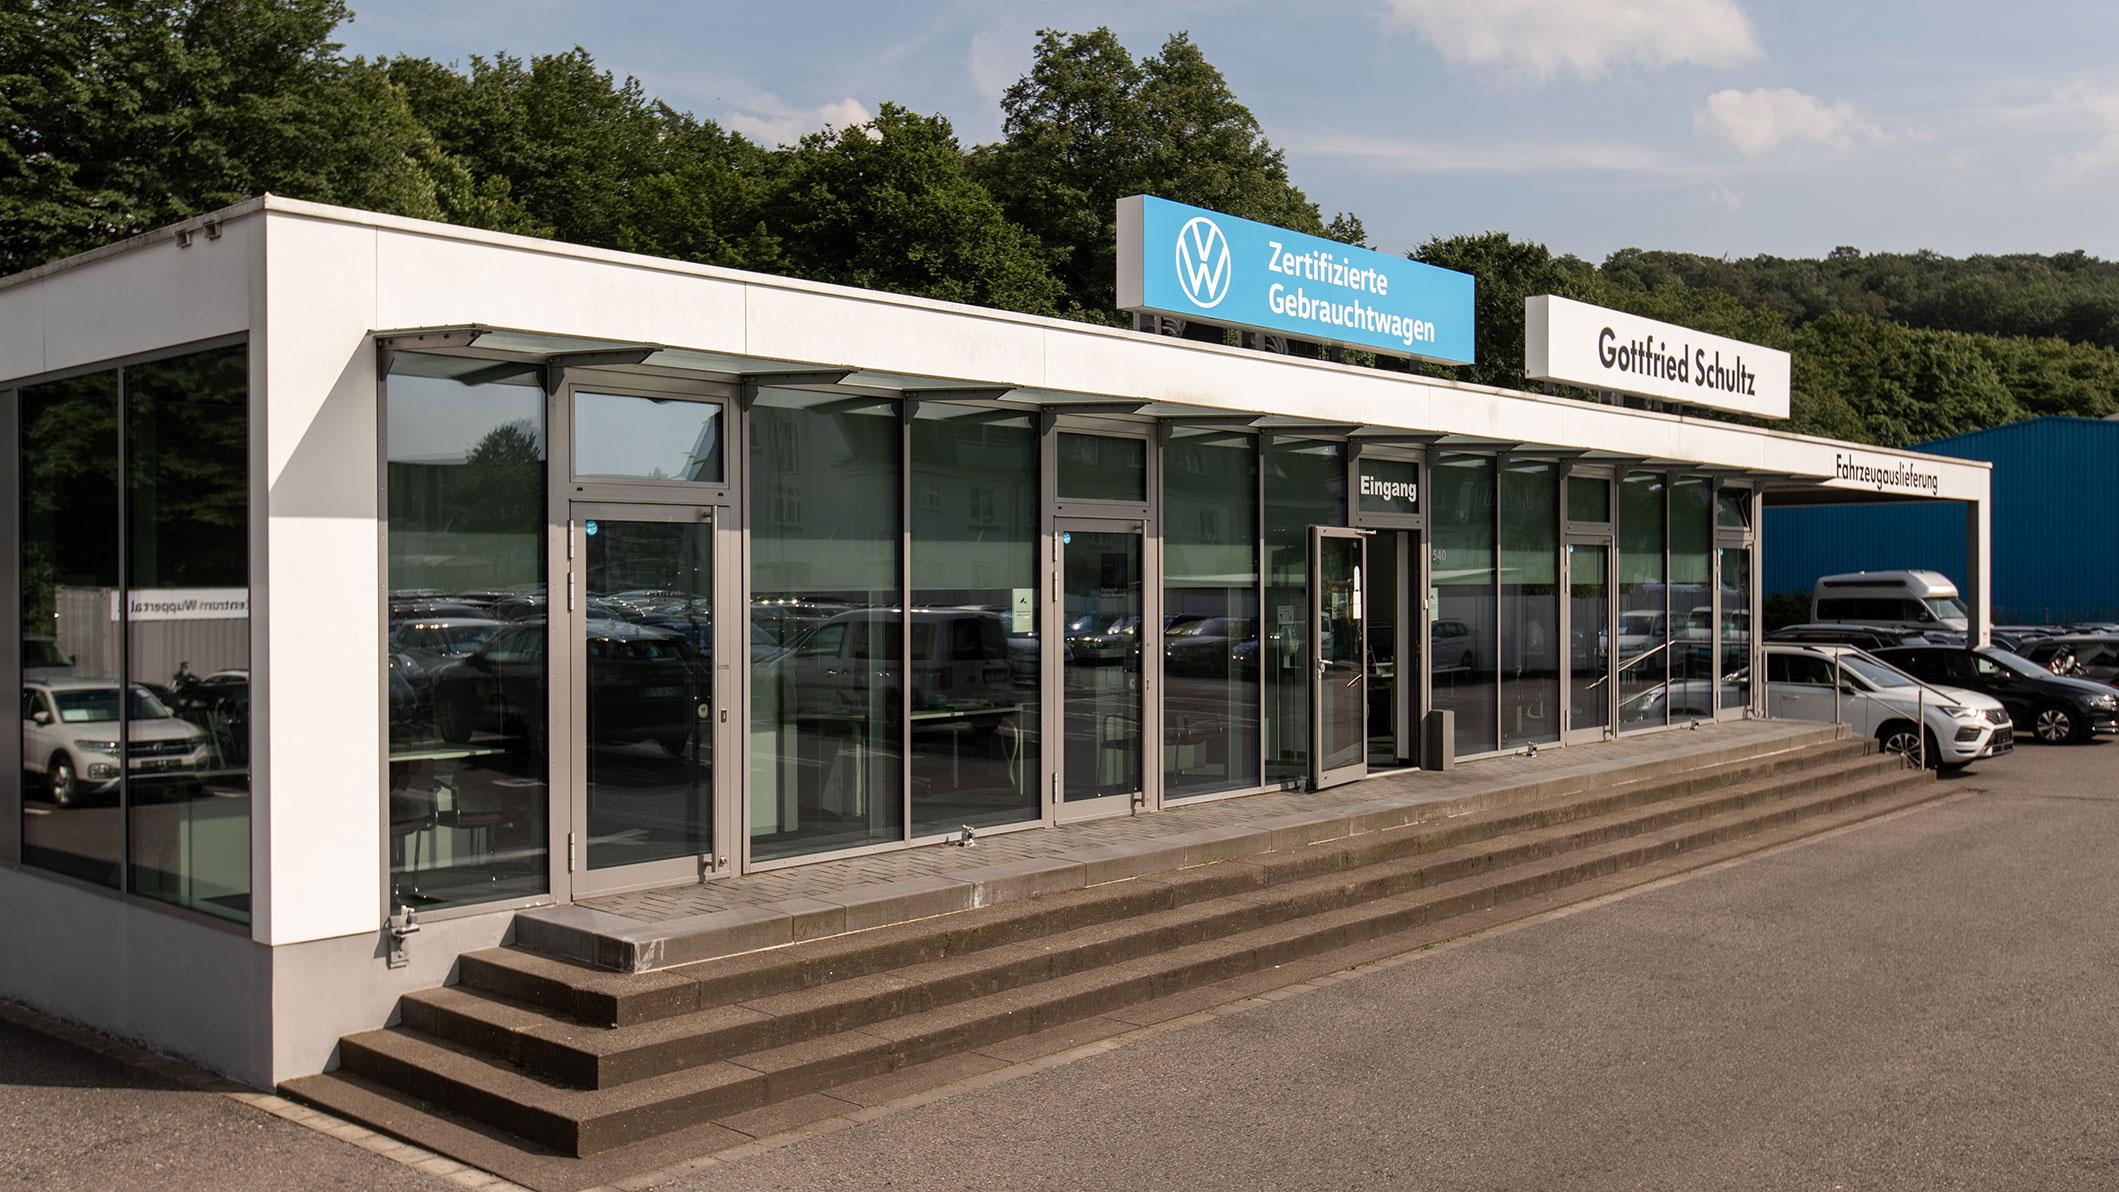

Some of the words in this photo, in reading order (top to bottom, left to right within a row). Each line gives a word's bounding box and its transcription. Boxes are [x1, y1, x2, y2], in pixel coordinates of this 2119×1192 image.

[1176, 217, 1231, 308] VW
[1268, 241, 1388, 296] Zertifizierte
[1268, 283, 1435, 346] Gebrauchtwagen
[1598, 326, 1689, 384] Gottfried
[1695, 348, 1756, 396] Schultz
[1360, 475, 1417, 503] Eingang
[1836, 453, 1938, 496] Fahrzeugauslieferung
